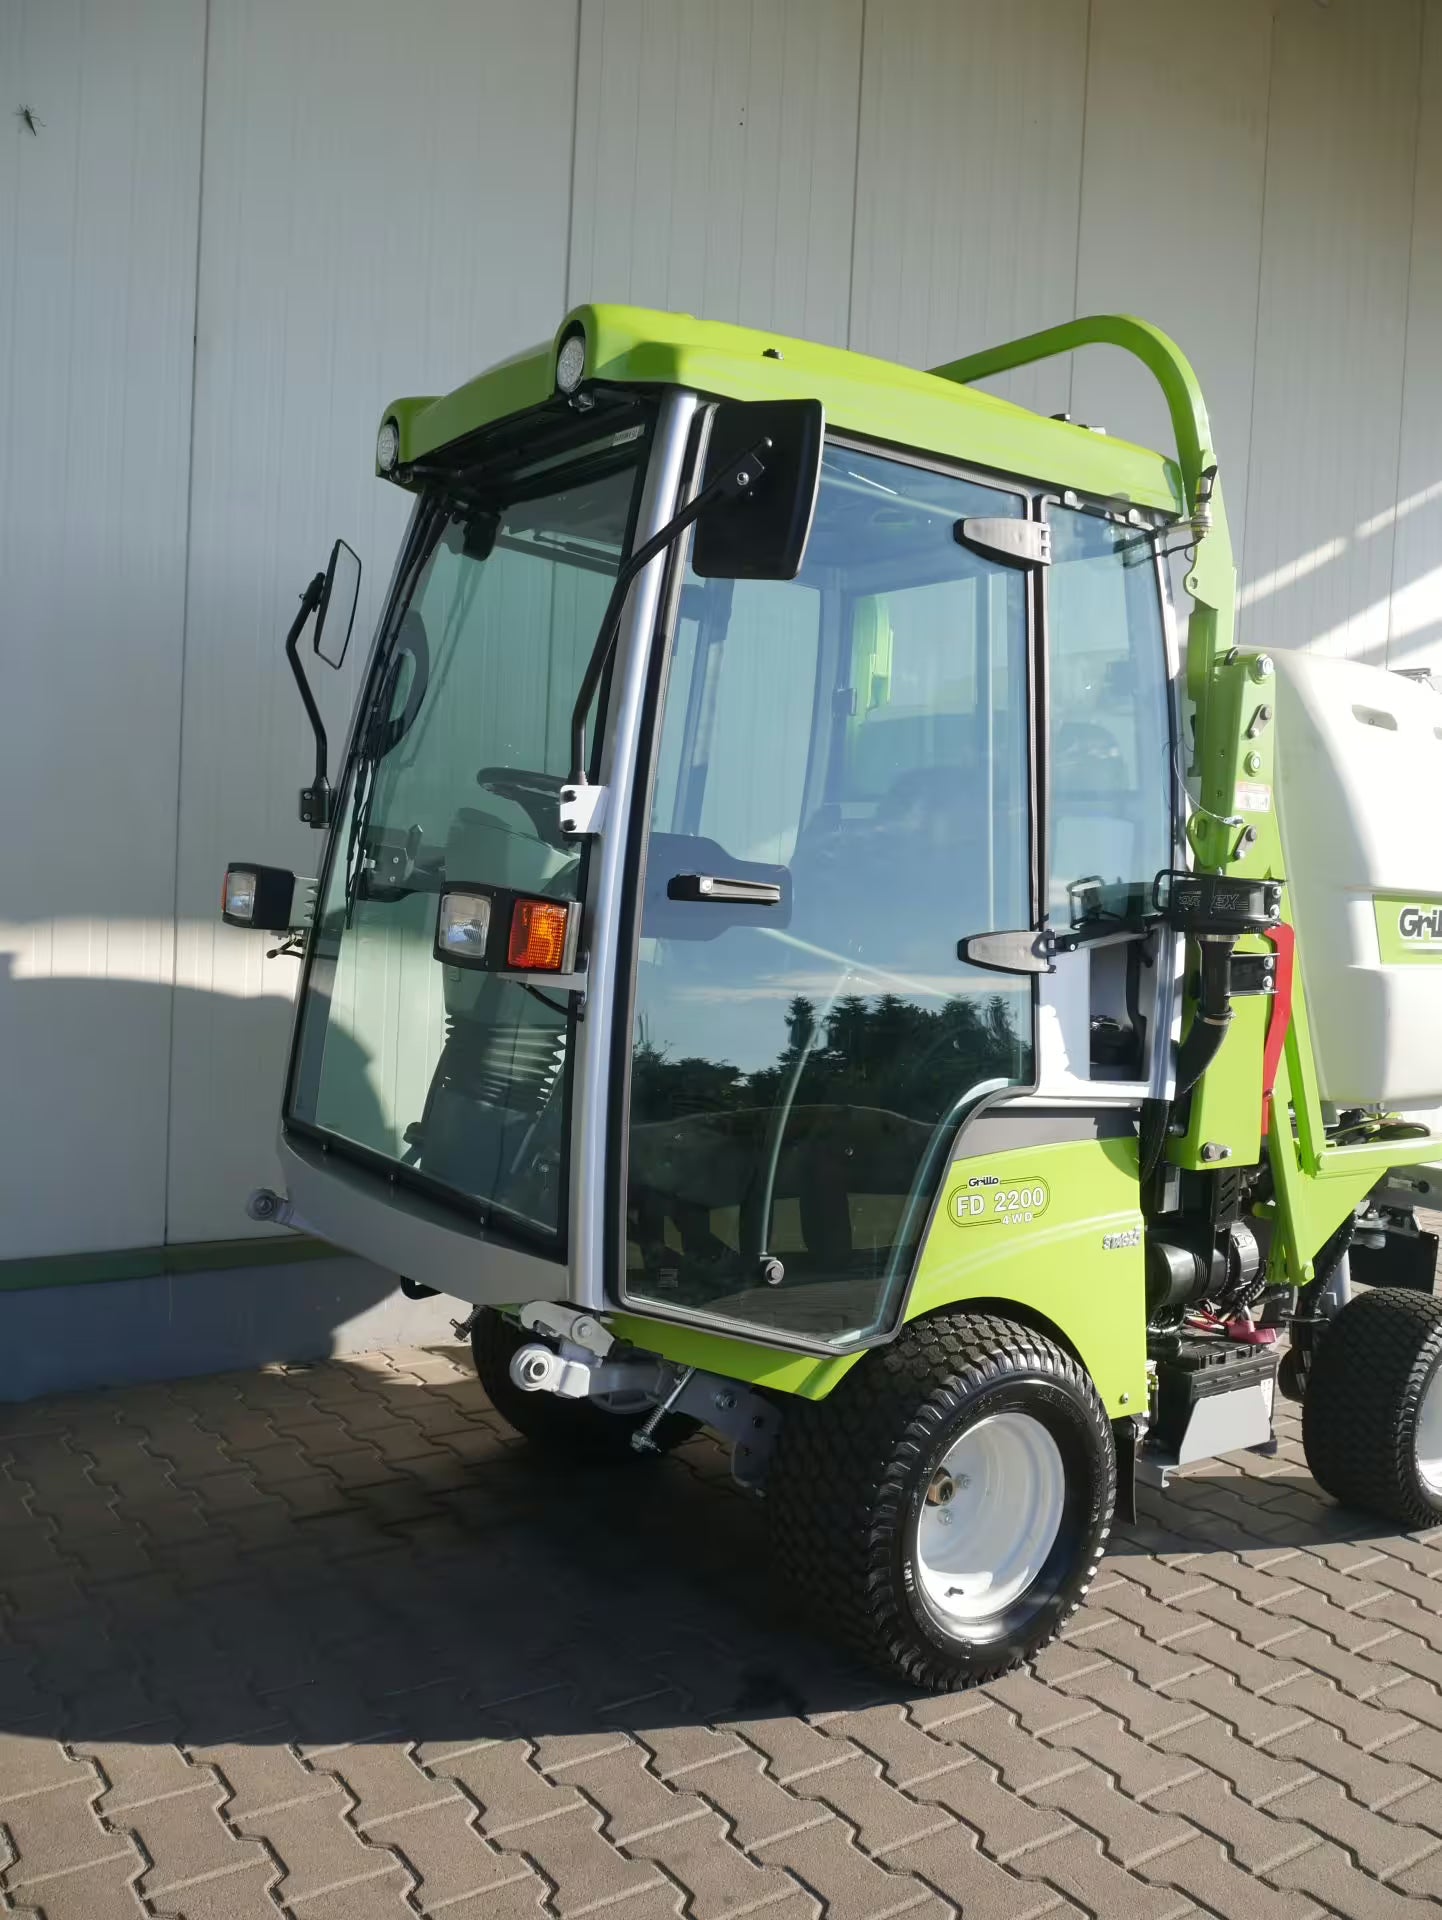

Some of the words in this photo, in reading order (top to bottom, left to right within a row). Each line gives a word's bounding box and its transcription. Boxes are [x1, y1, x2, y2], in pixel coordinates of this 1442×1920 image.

[968, 1176, 999, 1187] Grillo
[957, 1194, 985, 1217] FD
[994, 1187, 1044, 1212] 2200
